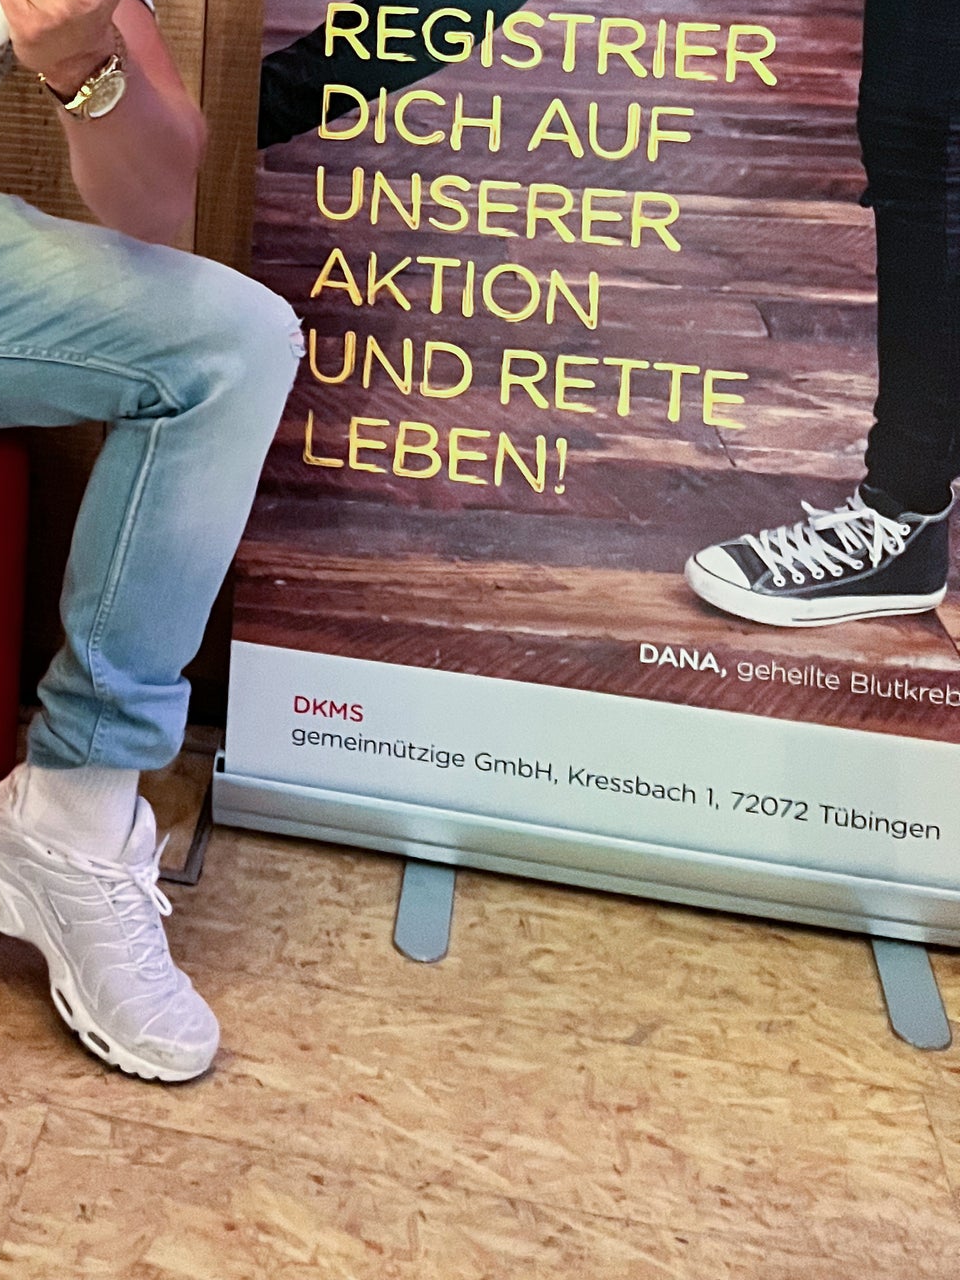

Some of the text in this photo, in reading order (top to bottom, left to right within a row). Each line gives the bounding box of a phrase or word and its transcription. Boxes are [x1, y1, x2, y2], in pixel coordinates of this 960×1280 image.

[324, 1, 778, 87] REGISTRIER
[318, 83, 696, 163] DICH AUF
[315, 165, 682, 252] UNSERER
[310, 247, 601, 330] AKTION
[308, 328, 750, 430] UND RETTE
[302, 410, 568, 496] LEBEN!
[293, 695, 364, 723] DKMS
[639, 642, 727, 679] DANA,
[737, 660, 841, 691] geheilte
[291, 727, 942, 841] gemeinnützige GmbH, Kressbach 1, 72072 Tübingen
